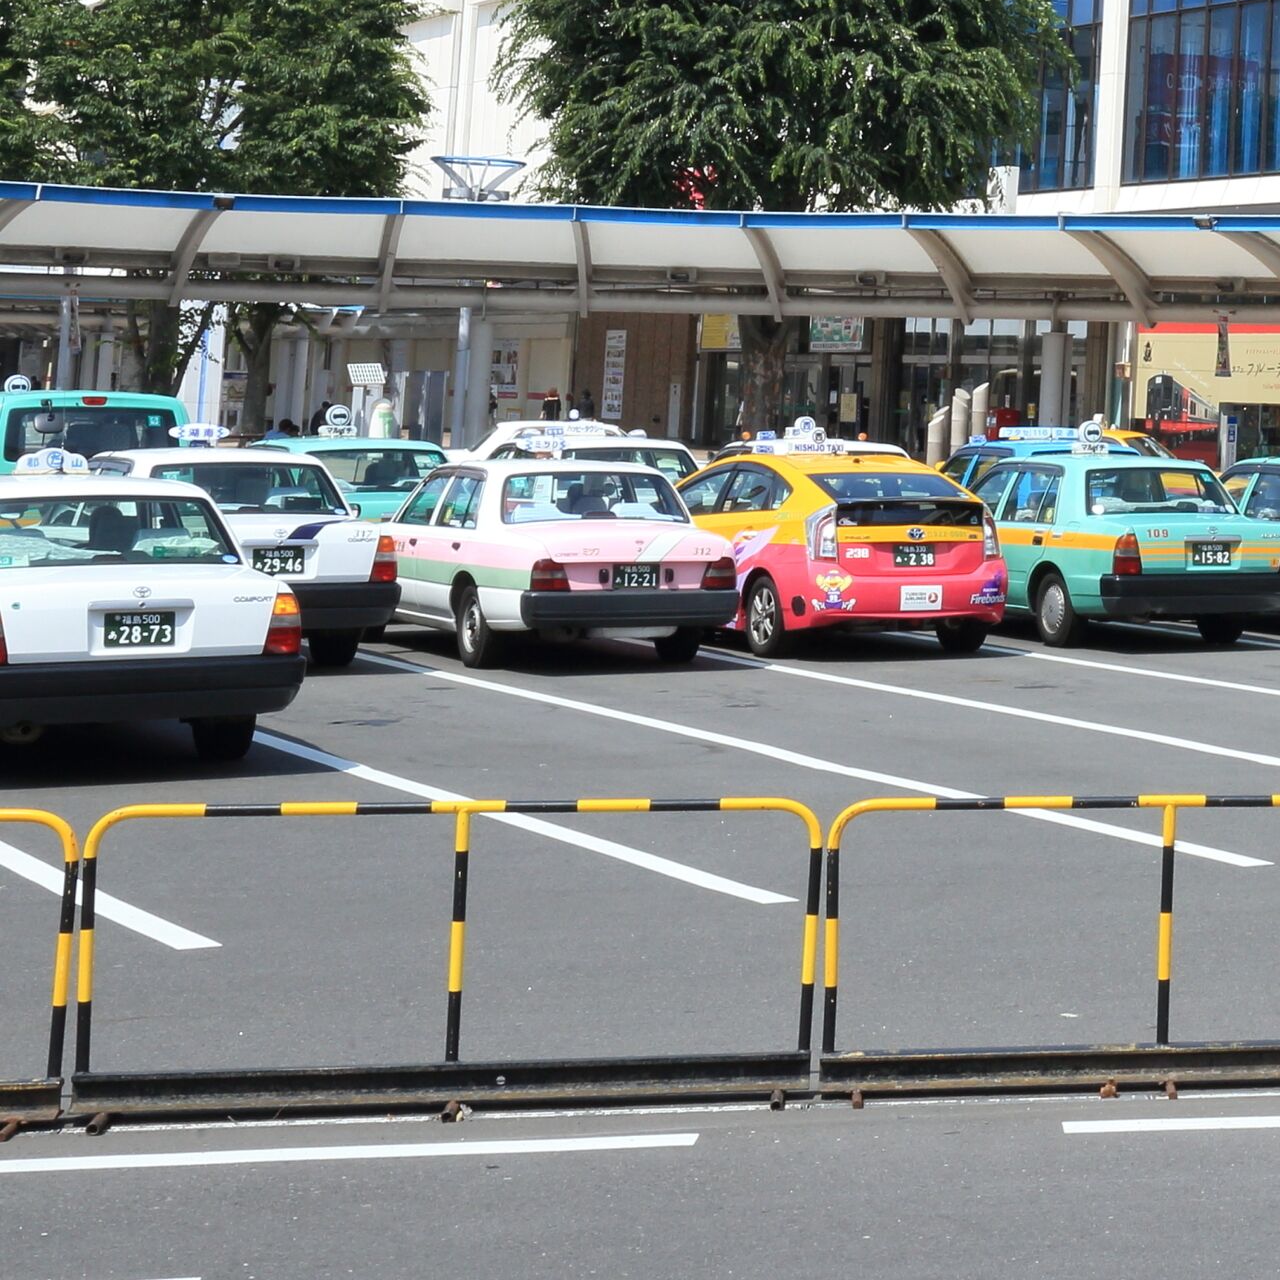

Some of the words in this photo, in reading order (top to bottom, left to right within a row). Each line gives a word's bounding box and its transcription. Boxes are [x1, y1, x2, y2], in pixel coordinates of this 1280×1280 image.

[794, 442, 825, 452] NISHIJO
[827, 442, 844, 452] TAXI
[1147, 529, 1169, 539] 109
[845, 547, 870, 559] 238
[1201, 551, 1230, 564] 15-82
[263, 558, 302, 573] 29-46
[623, 573, 658, 588] 12-21
[233, 595, 274, 603] COMFORT
[122, 614, 161, 624] 福島500
[118, 624, 172, 644] 28-73
